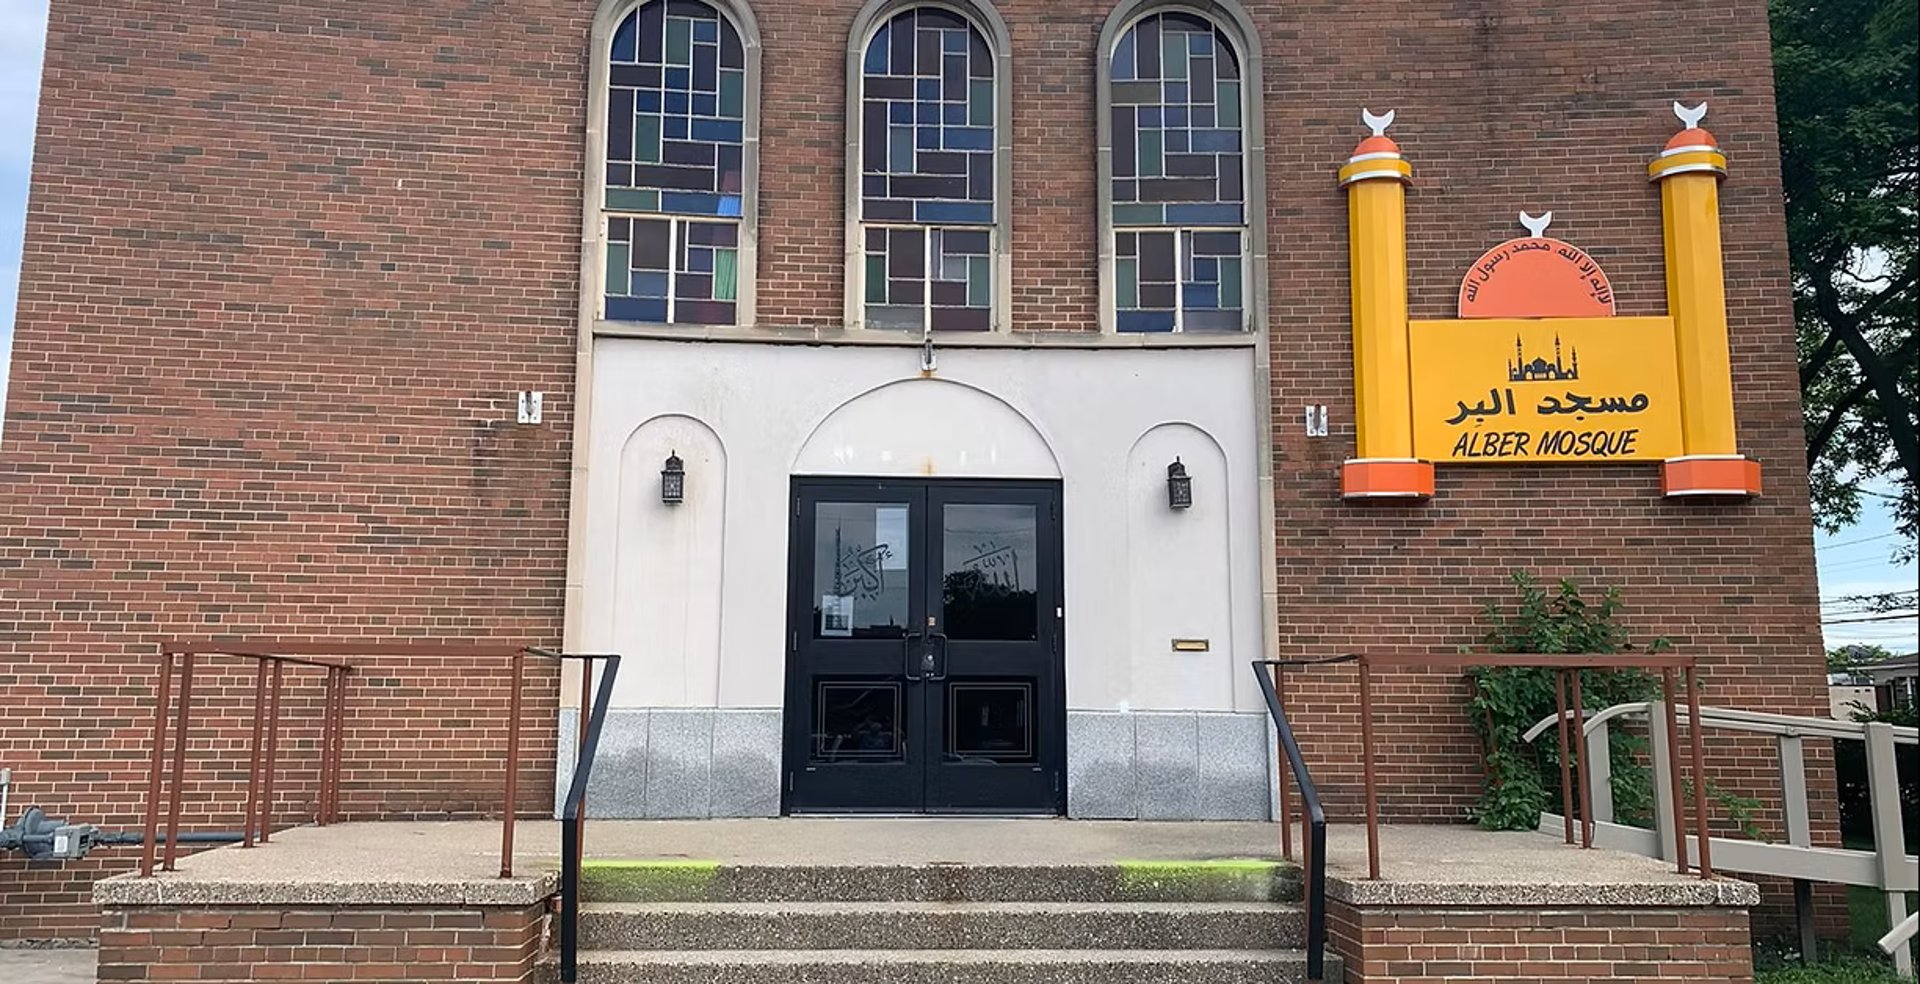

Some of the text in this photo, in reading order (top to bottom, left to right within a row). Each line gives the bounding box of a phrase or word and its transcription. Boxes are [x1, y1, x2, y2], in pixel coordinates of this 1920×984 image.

[1512, 242, 1551, 254] محمد
[1558, 249, 1583, 264] الله
[1477, 251, 1510, 282] رسول
[1467, 279, 1480, 303] الله
[1537, 391, 1649, 421] مسجد
[1452, 429, 1639, 457] ALBER MOSQUE
